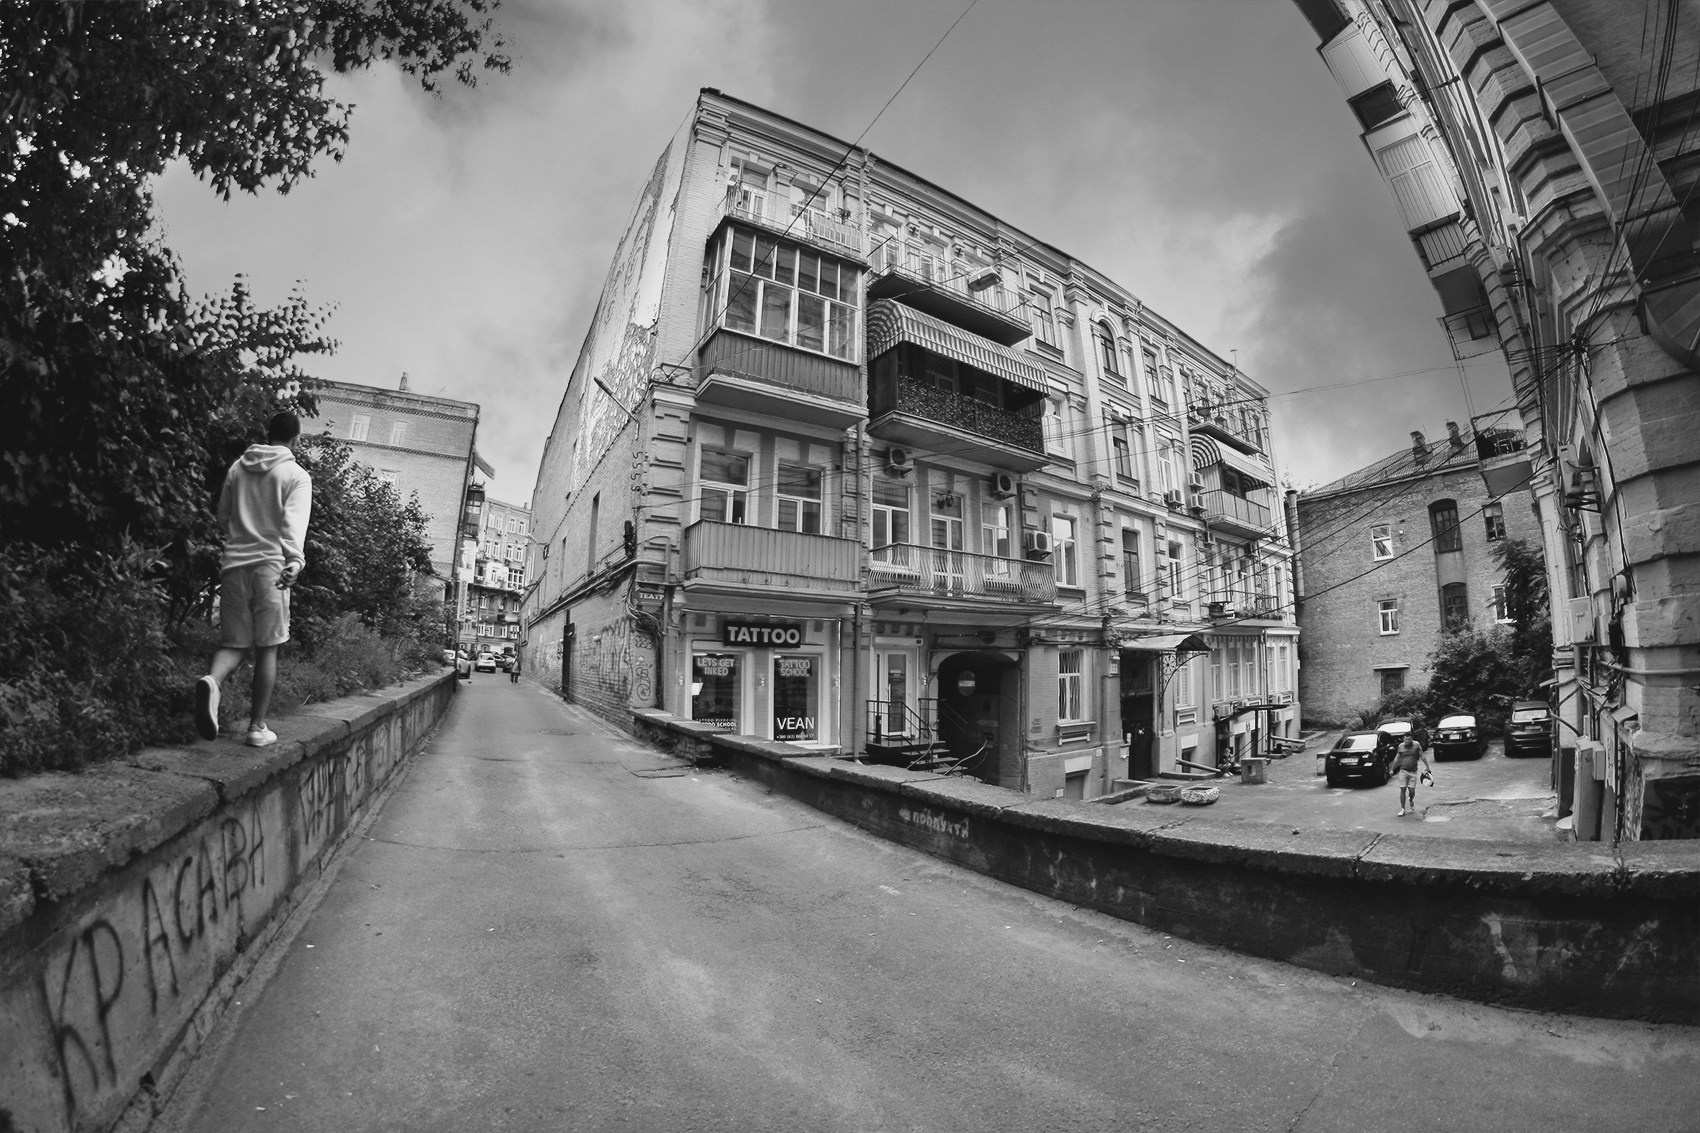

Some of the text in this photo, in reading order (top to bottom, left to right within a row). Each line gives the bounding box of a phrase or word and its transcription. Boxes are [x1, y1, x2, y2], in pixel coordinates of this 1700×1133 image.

[727, 626, 800, 644] TATTOO
[697, 657, 735, 668] LETS GET
[779, 659, 811, 669] TATTOO
[704, 667, 729, 676] INKED
[780, 668, 810, 677] SCHOOL
[776, 717, 815, 730] VEAN
